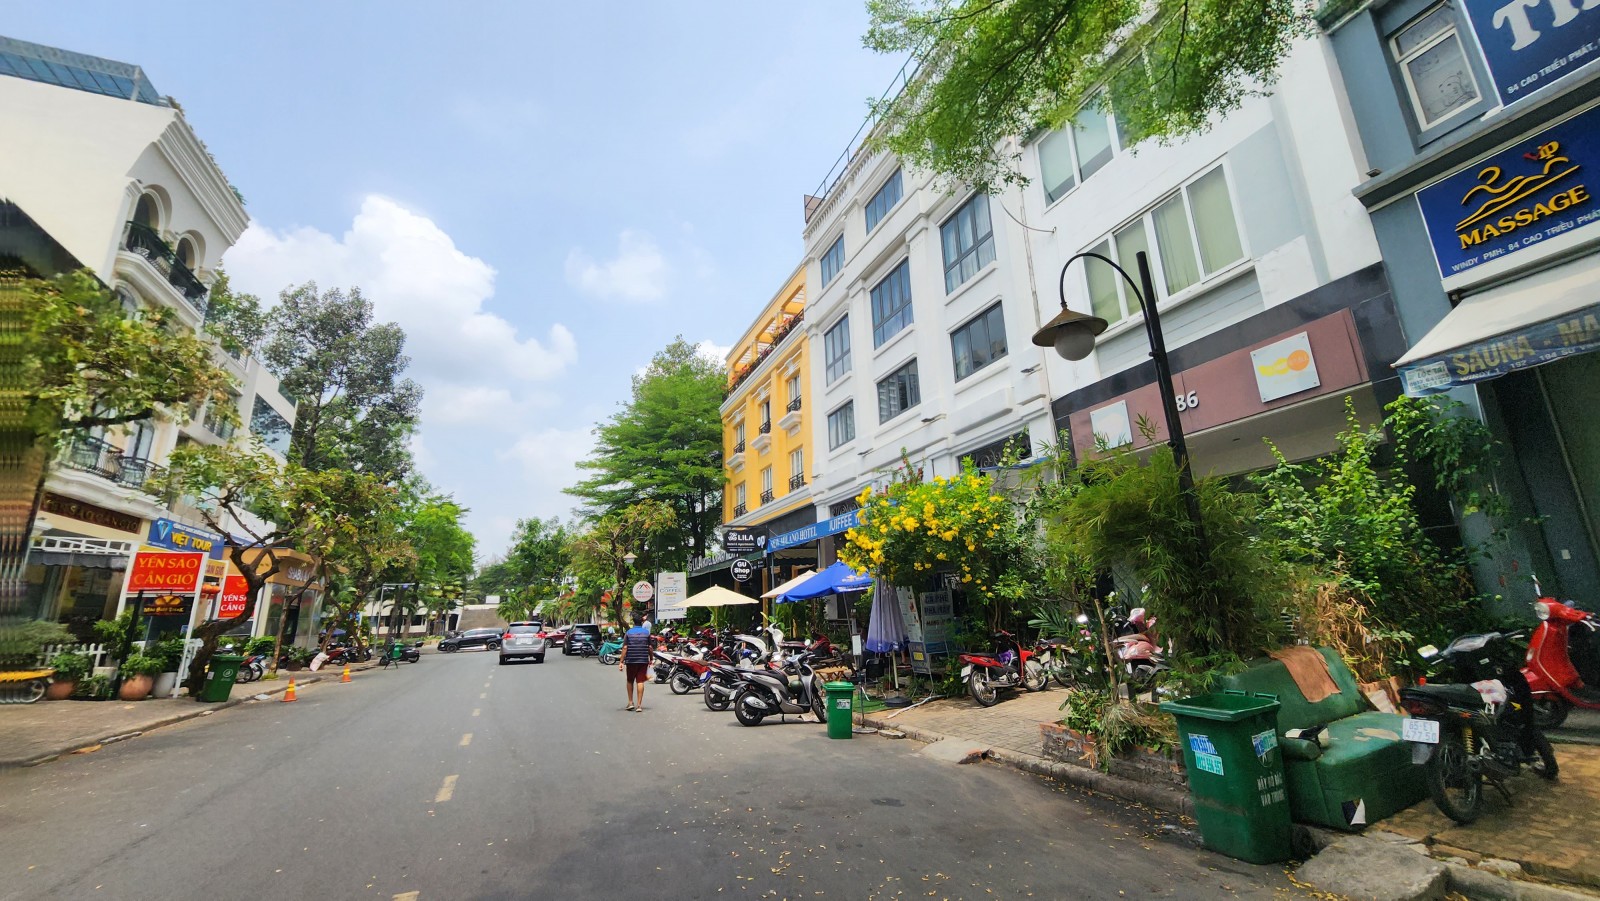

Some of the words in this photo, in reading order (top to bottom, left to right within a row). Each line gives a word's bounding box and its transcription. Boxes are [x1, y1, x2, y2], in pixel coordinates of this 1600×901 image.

[1520, 73, 1539, 87] CAO
[1458, 184, 1590, 250] MASSAGE
[1451, 256, 1479, 272] WINDY
[1483, 248, 1505, 260] PMH:
[1508, 241, 1520, 251] 84
[1522, 232, 1543, 245] CAO
[1452, 335, 1536, 376] SAUNA
[1510, 360, 1527, 369] 192
[1539, 351, 1557, 361] 194
[1175, 390, 1199, 412] 86
[799, 526, 817, 541] HOTEL
[191, 537, 212, 551] TOUR
[139, 555, 166, 568] YẾN
[167, 556, 198, 569] SÀO
[134, 571, 164, 585] CẦN
[166, 572, 194, 585] GIỜ
[734, 567, 750, 575] Shop
